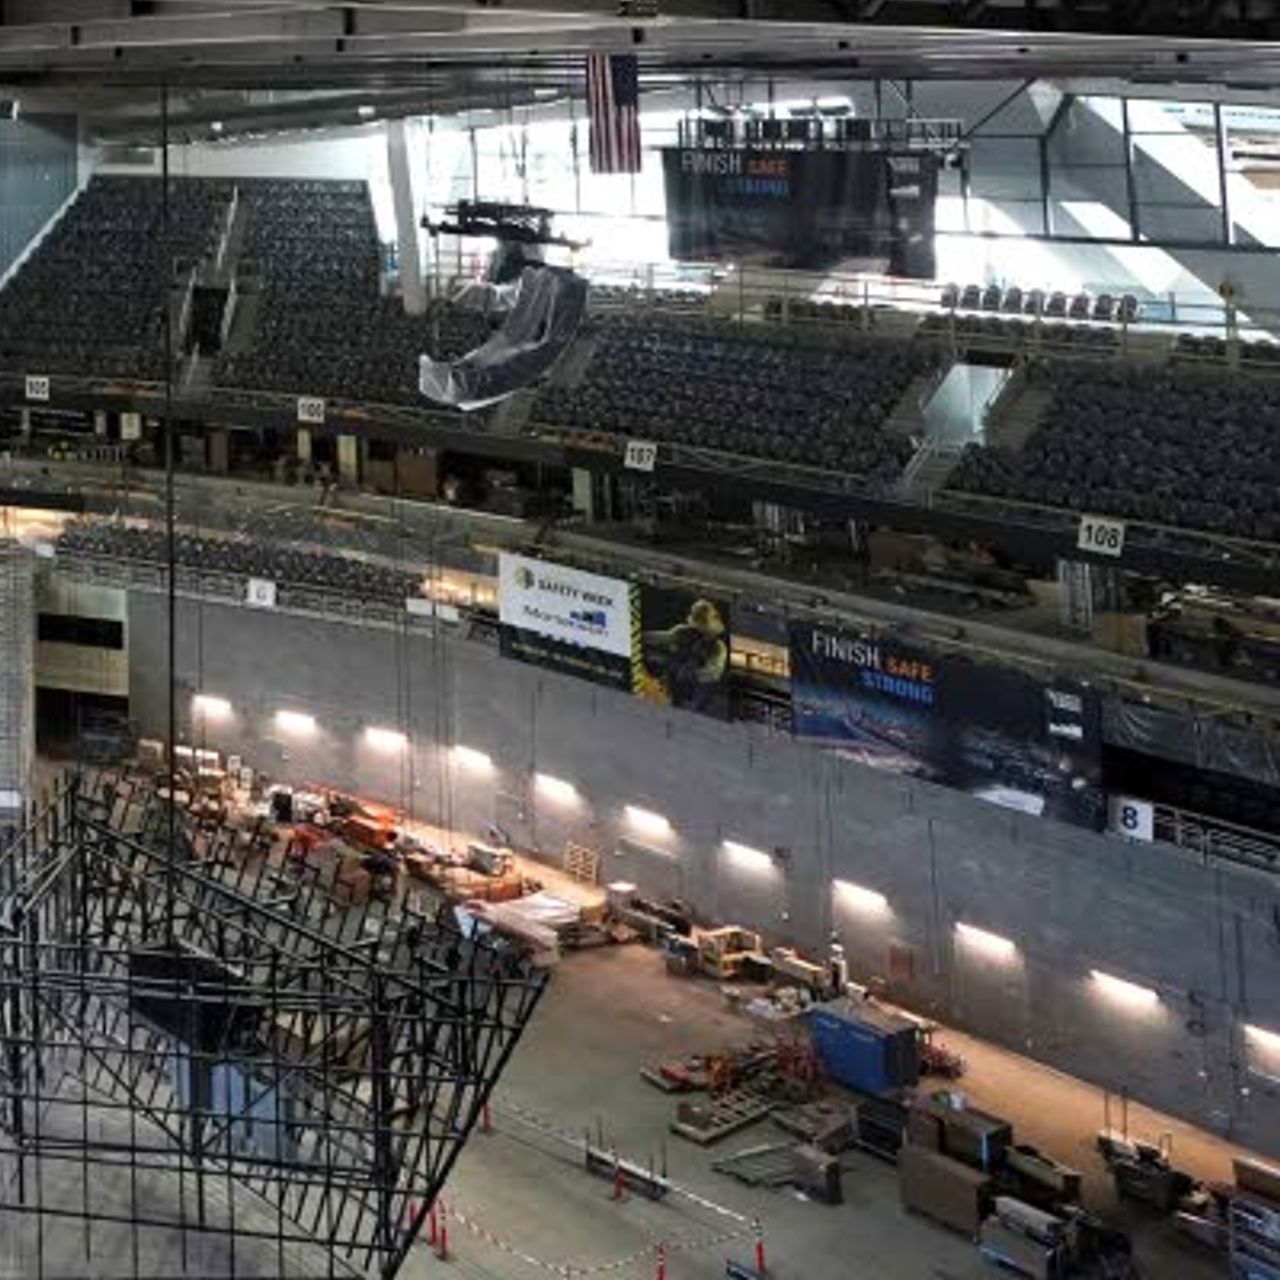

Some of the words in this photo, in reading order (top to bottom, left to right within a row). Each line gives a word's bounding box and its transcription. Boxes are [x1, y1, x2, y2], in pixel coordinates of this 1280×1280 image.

[681, 149, 742, 174] FINISH
[1084, 523, 1120, 550] 108
[811, 629, 880, 670] FINISH
[883, 655, 933, 682] SAFE
[862, 668, 933, 705] STRONG
[1122, 805, 1138, 831] 8
